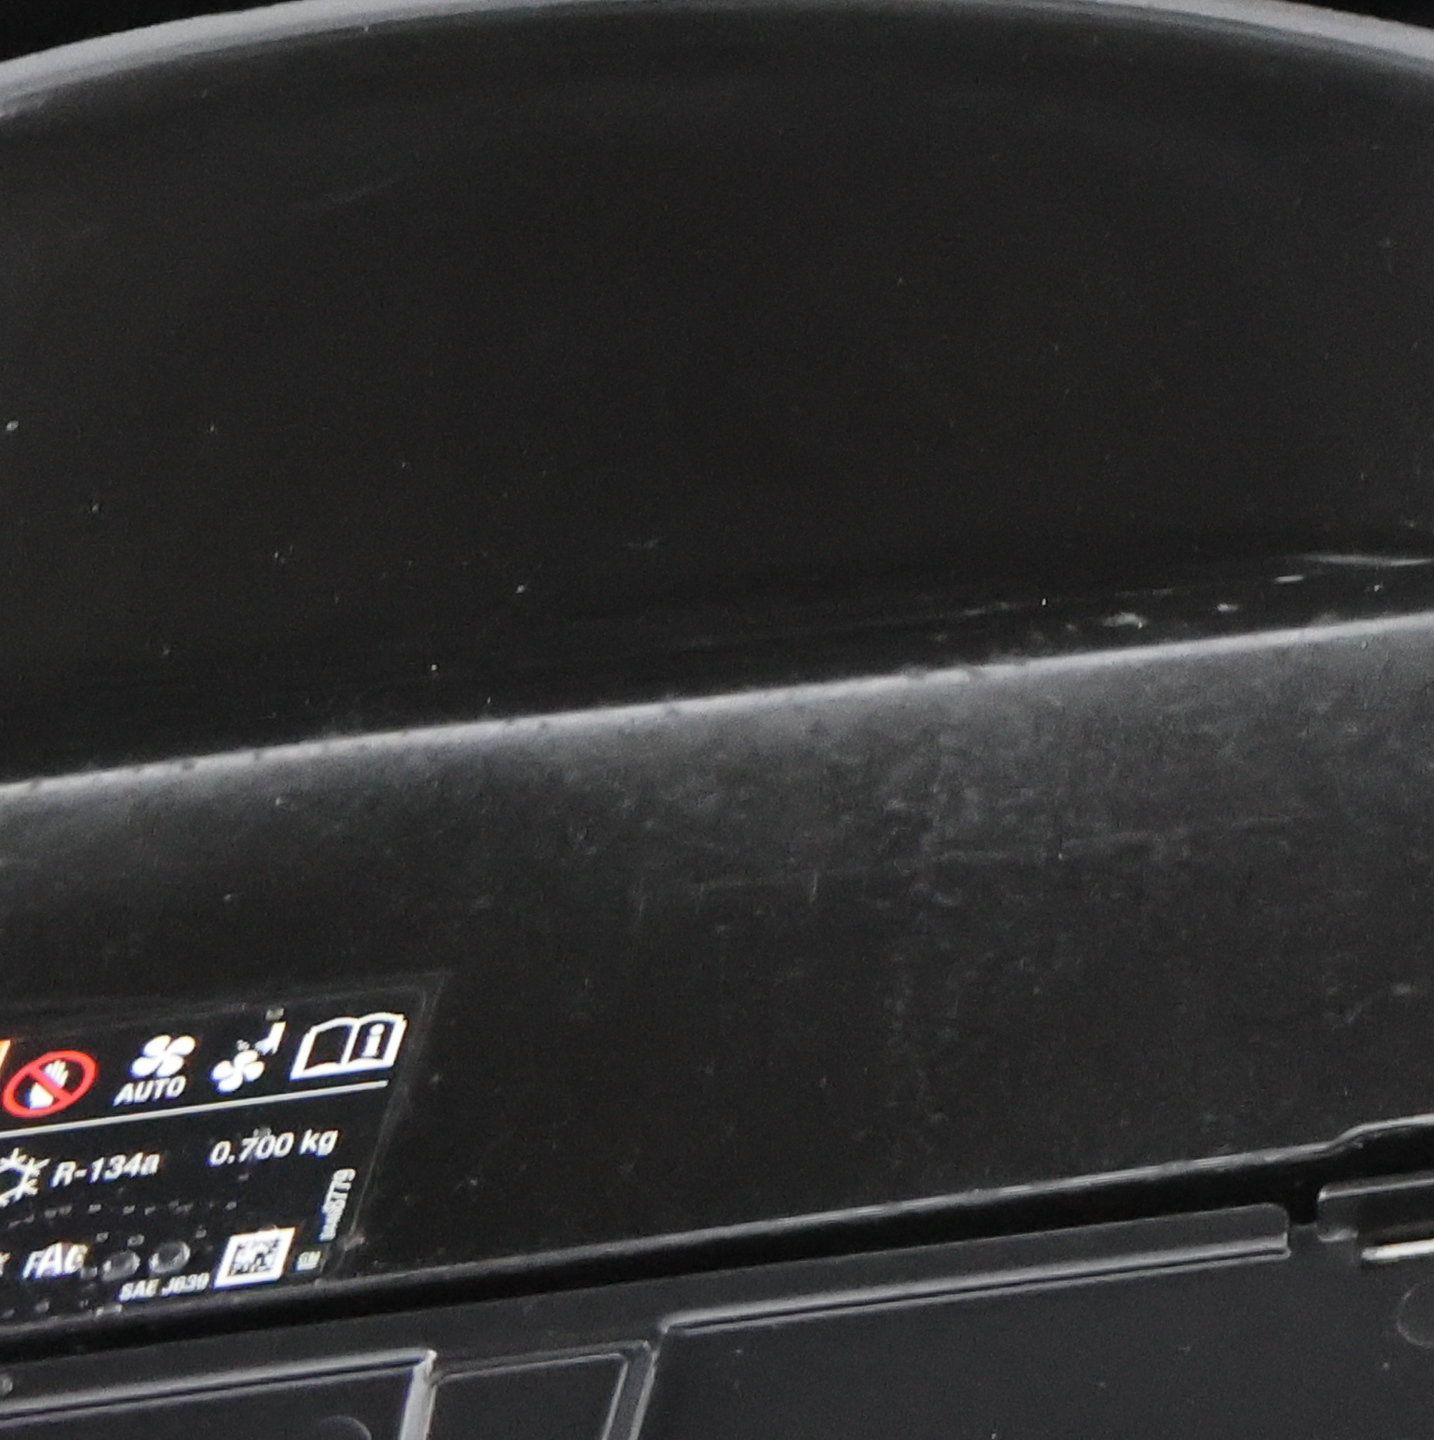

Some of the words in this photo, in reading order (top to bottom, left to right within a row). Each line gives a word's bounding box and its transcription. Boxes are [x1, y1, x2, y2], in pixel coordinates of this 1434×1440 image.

[112, 1075, 187, 1107] AUTO
[50, 1152, 162, 1189] R-134a
[208, 1129, 296, 1167] 0.700
[300, 1127, 340, 1159] kg
